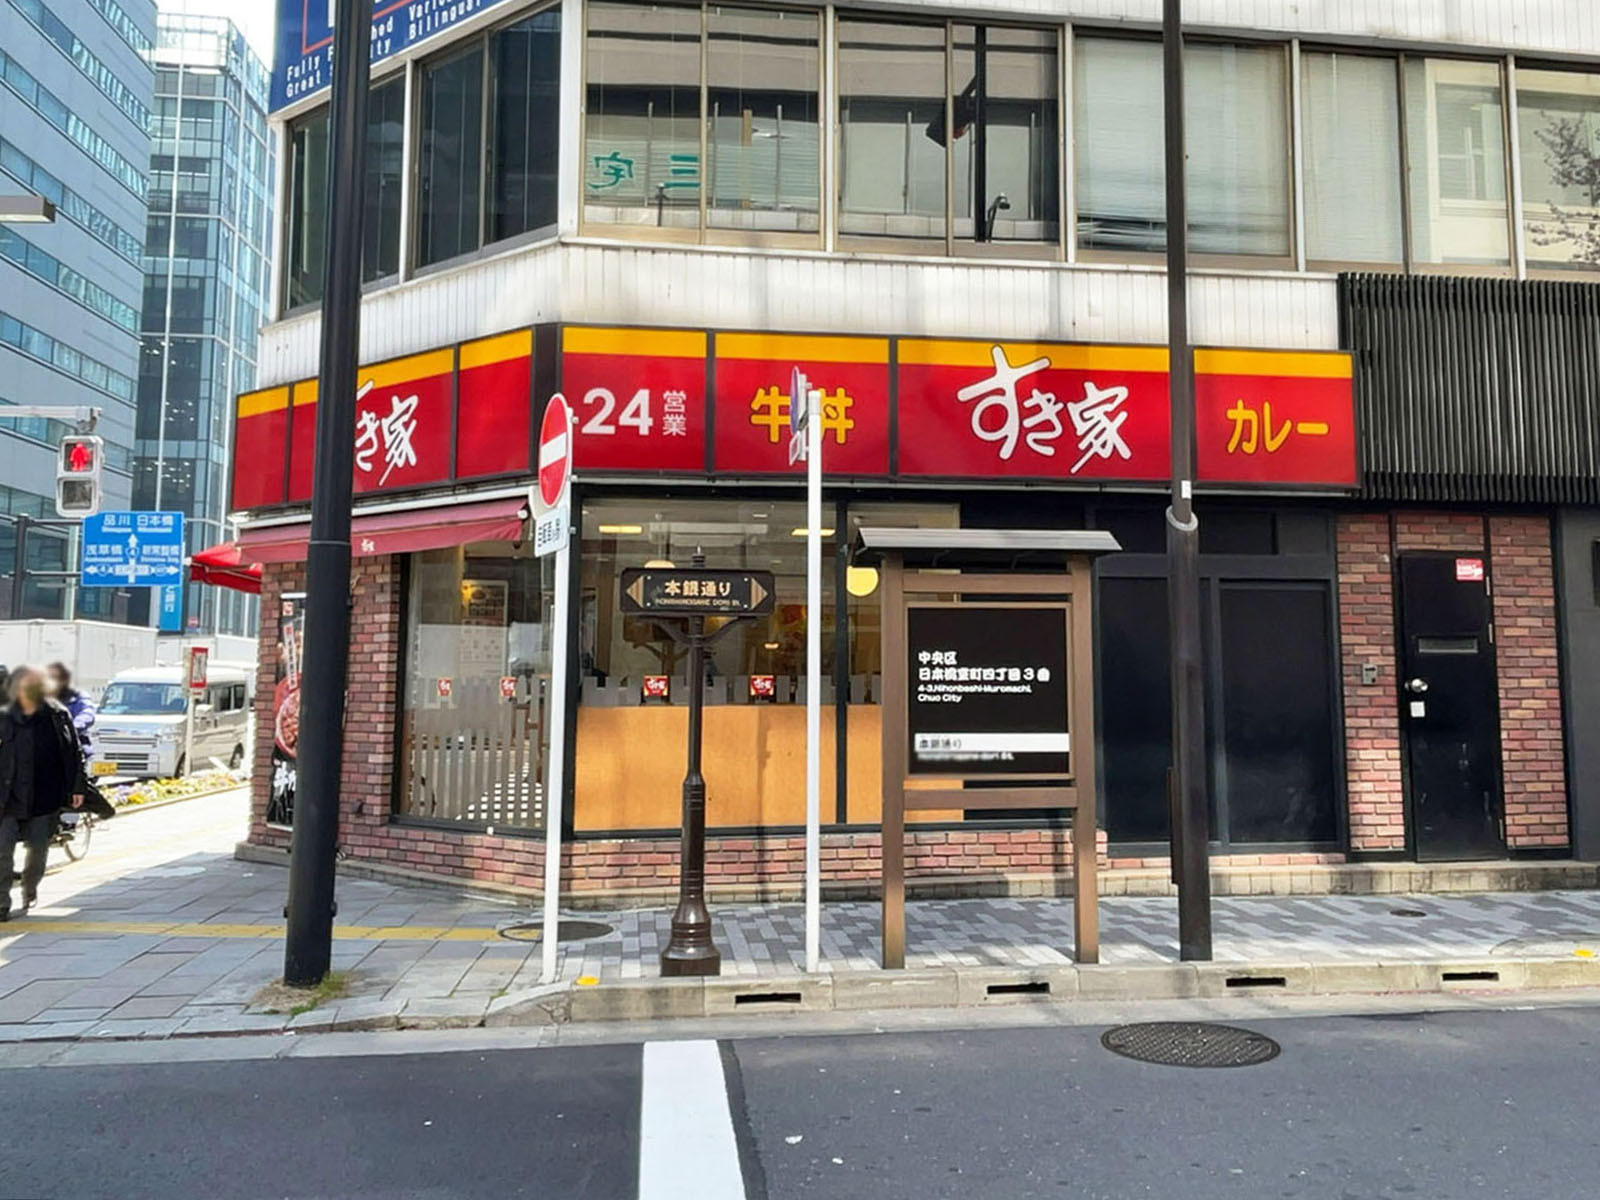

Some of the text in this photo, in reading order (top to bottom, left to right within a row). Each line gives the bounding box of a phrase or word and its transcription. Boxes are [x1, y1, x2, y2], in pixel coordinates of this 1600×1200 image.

[286, 55, 321, 82] Fully
[286, 69, 321, 98] Great
[581, 387, 687, 436] 24 営業
[750, 385, 854, 444] 牛丼
[956, 345, 1132, 475] すき家
[355, 379, 419, 486] き家
[1226, 399, 1329, 455] カレー
[103, 514, 174, 526] 品川 日本橋
[664, 579, 731, 597] 本銀通り
[918, 651, 957, 665] 中央区
[917, 693, 962, 703] Chuo City
